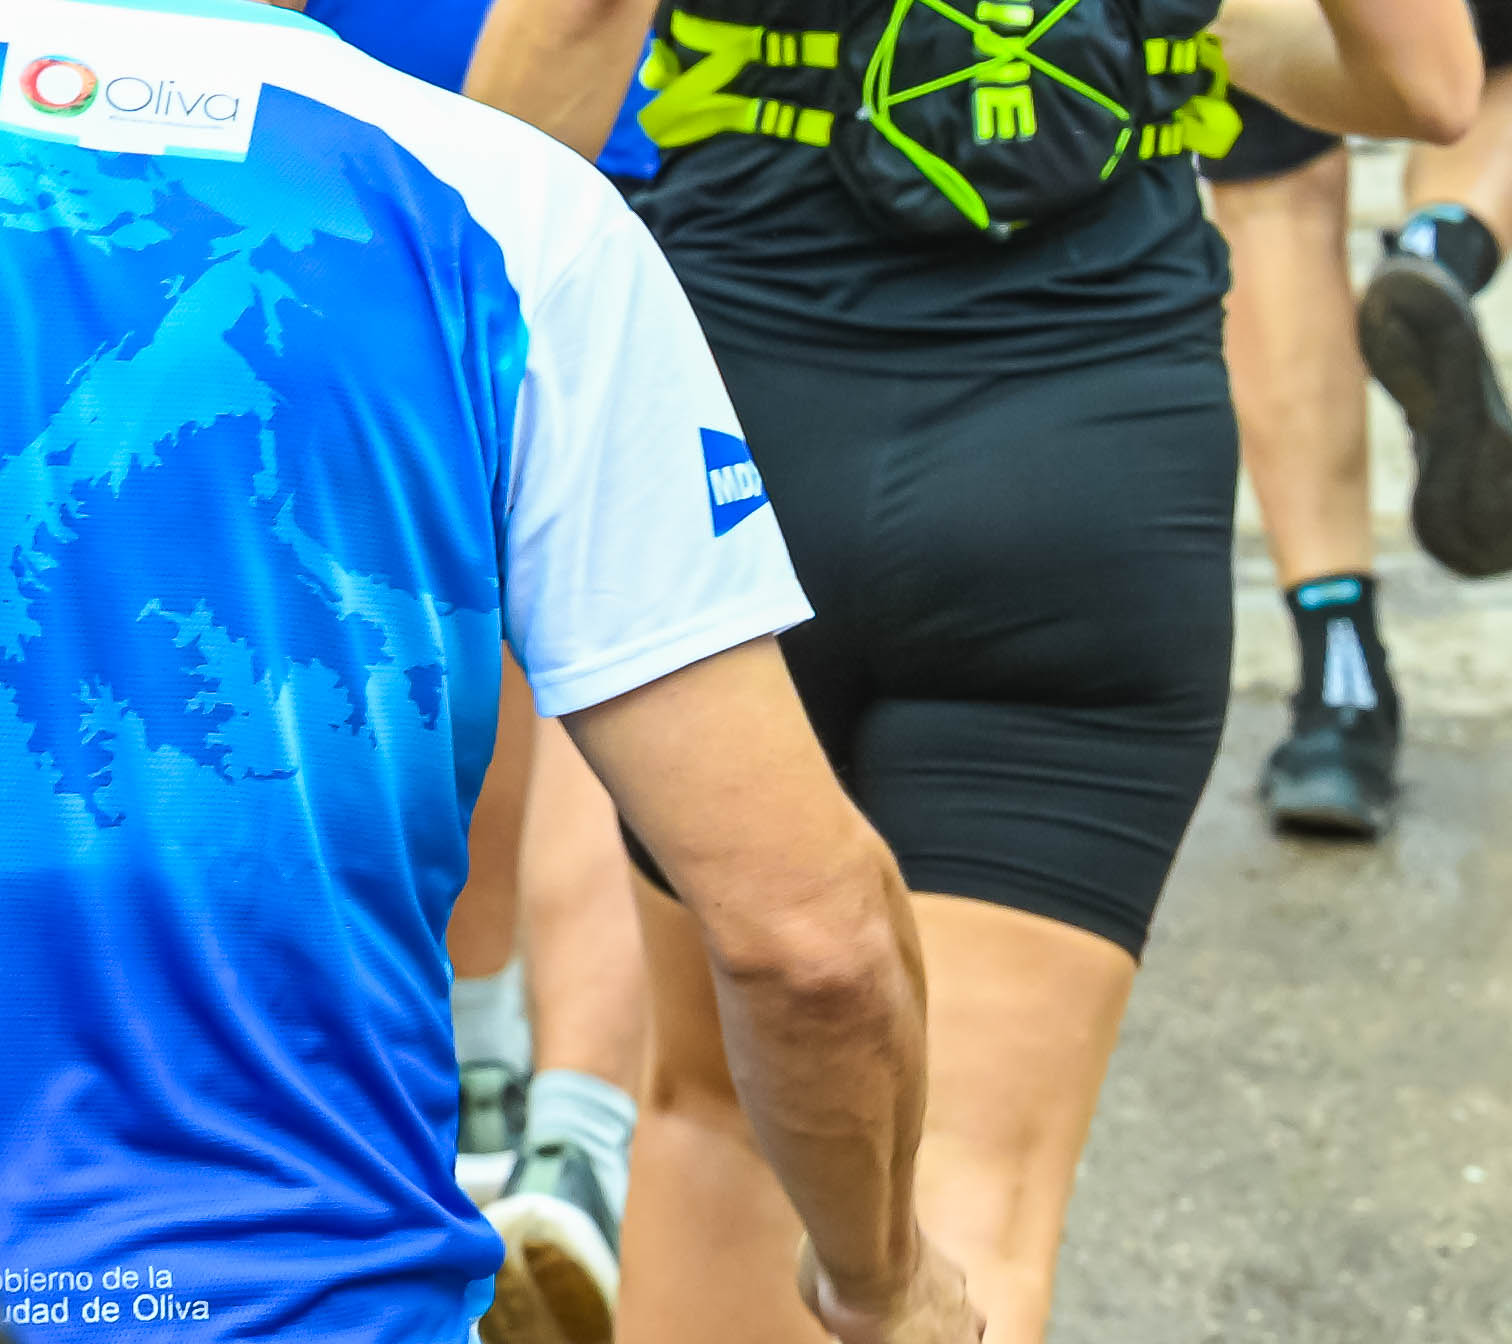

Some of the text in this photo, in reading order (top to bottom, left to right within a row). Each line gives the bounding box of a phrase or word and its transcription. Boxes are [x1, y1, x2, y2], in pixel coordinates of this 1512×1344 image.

[105, 76, 240, 123] Oliva
[102, 1266, 139, 1290] de
[148, 1265, 173, 1289] la
[81, 1296, 120, 1323] de
[132, 1293, 210, 1322] Oliva
